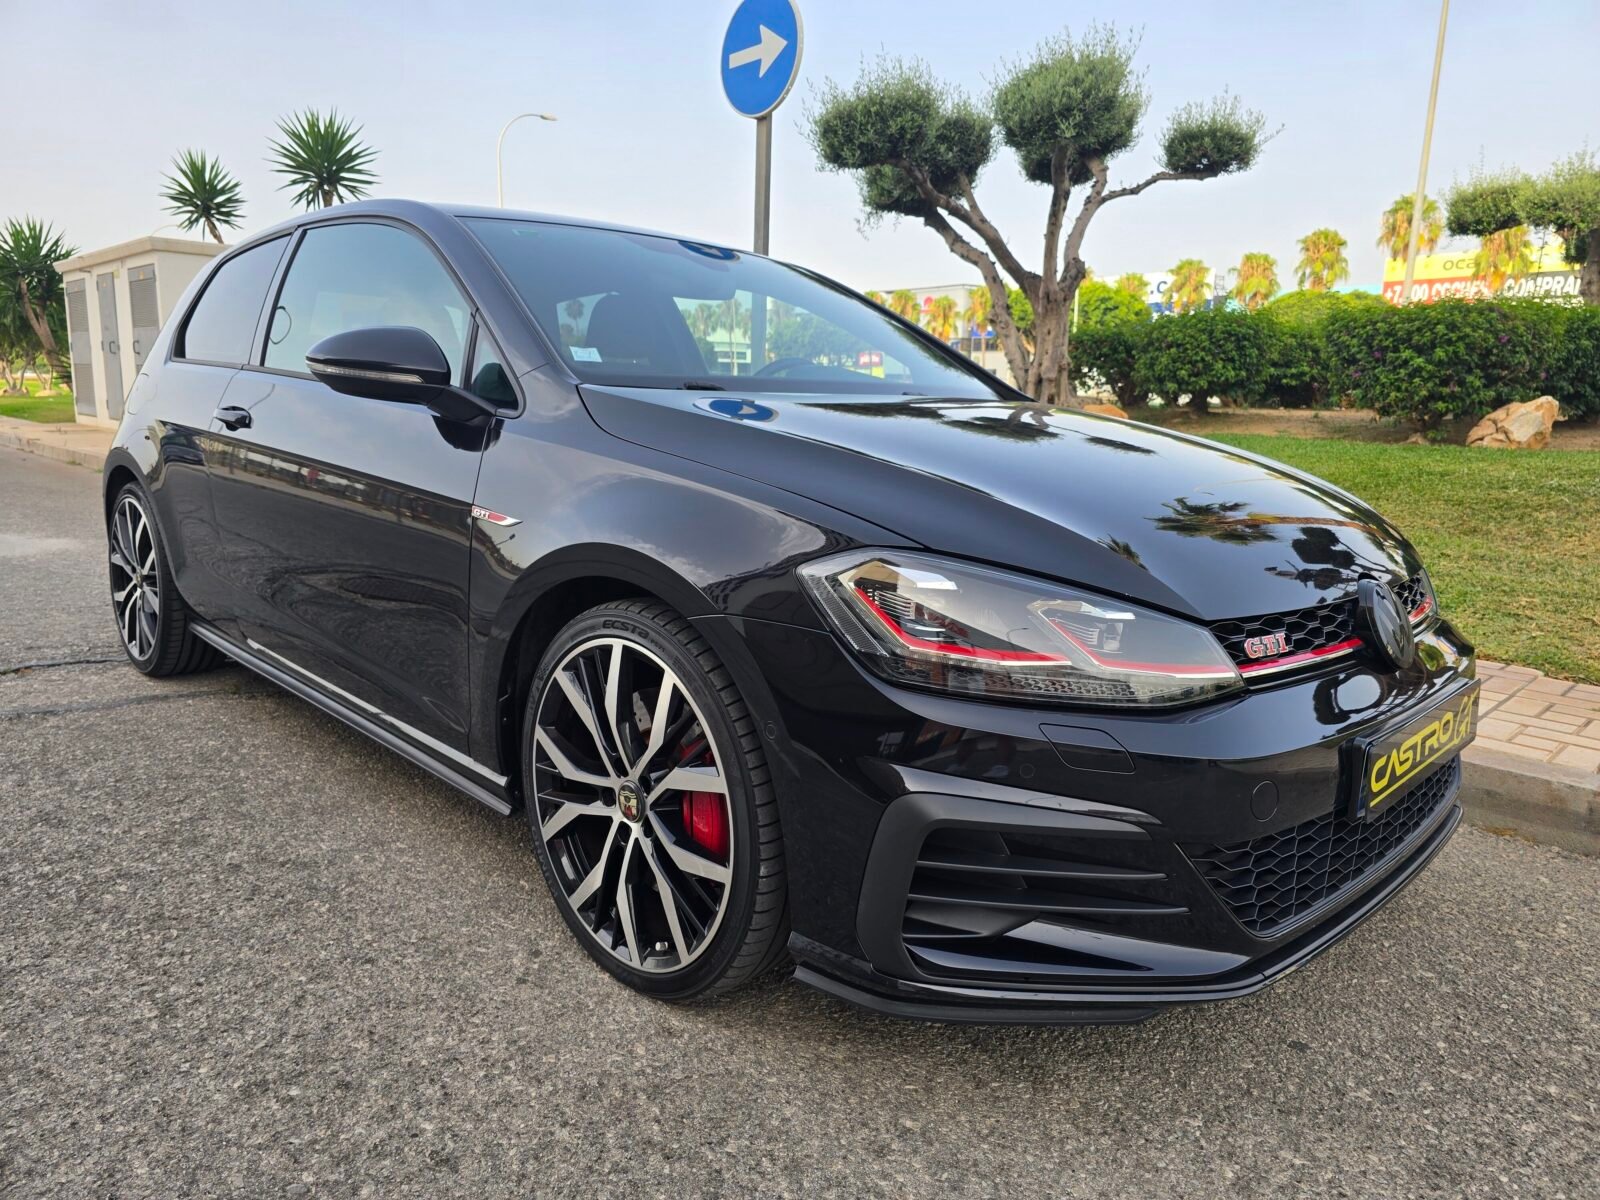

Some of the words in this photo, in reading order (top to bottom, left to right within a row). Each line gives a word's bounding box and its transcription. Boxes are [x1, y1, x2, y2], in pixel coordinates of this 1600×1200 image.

[1443, 258, 1476, 271] oca
[1384, 283, 1429, 303] +7.00
[474, 508, 489, 519] GTI
[1244, 632, 1289, 659] GTI
[1370, 711, 1454, 793] CASTRO
